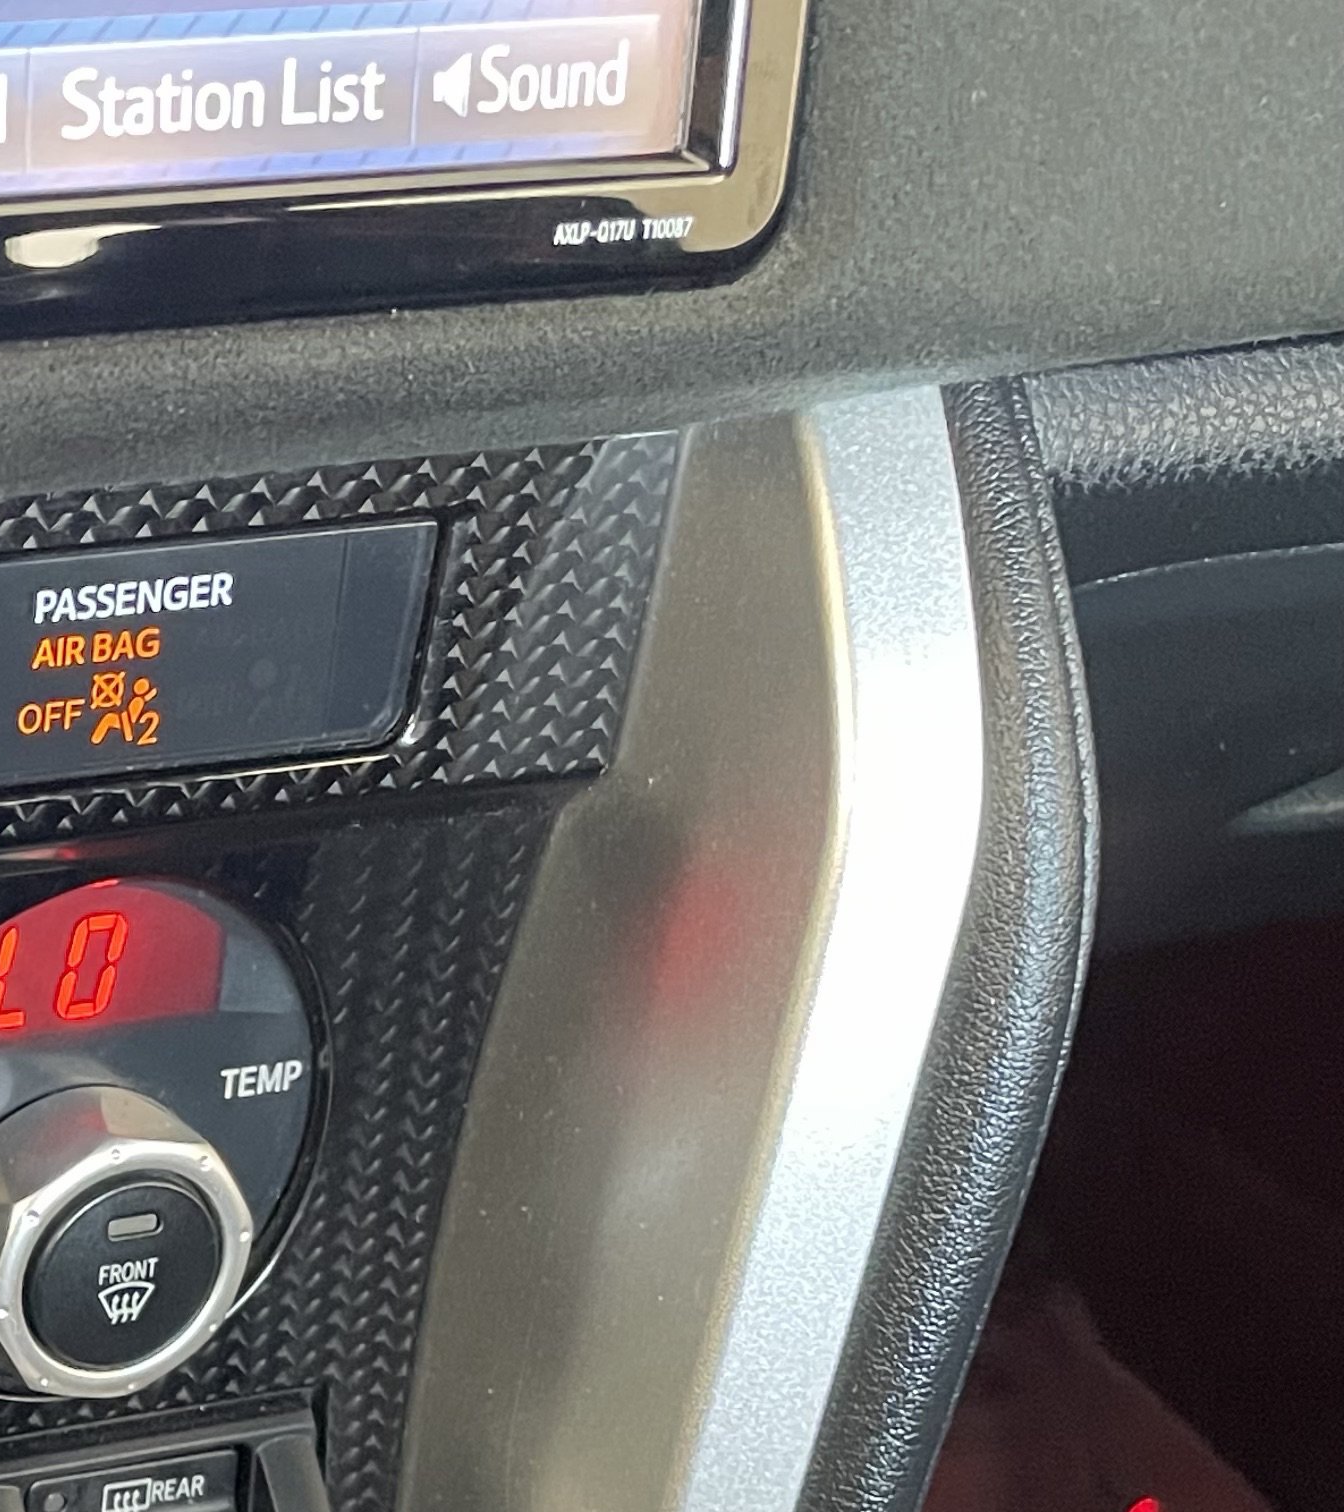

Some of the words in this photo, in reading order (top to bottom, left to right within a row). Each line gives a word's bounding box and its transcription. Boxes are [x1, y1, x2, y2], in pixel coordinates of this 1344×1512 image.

[476, 43, 629, 114] Sound
[59, 65, 273, 142] Station
[280, 60, 387, 128] List
[33, 571, 235, 625] PASSENGER
[30, 634, 86, 671] AIR
[90, 626, 162, 665] BAG
[17, 698, 86, 736] OFF
[219, 1058, 303, 1101] TEMP
[97, 1257, 159, 1286] FRONT
[148, 1471, 208, 1505] REAR
